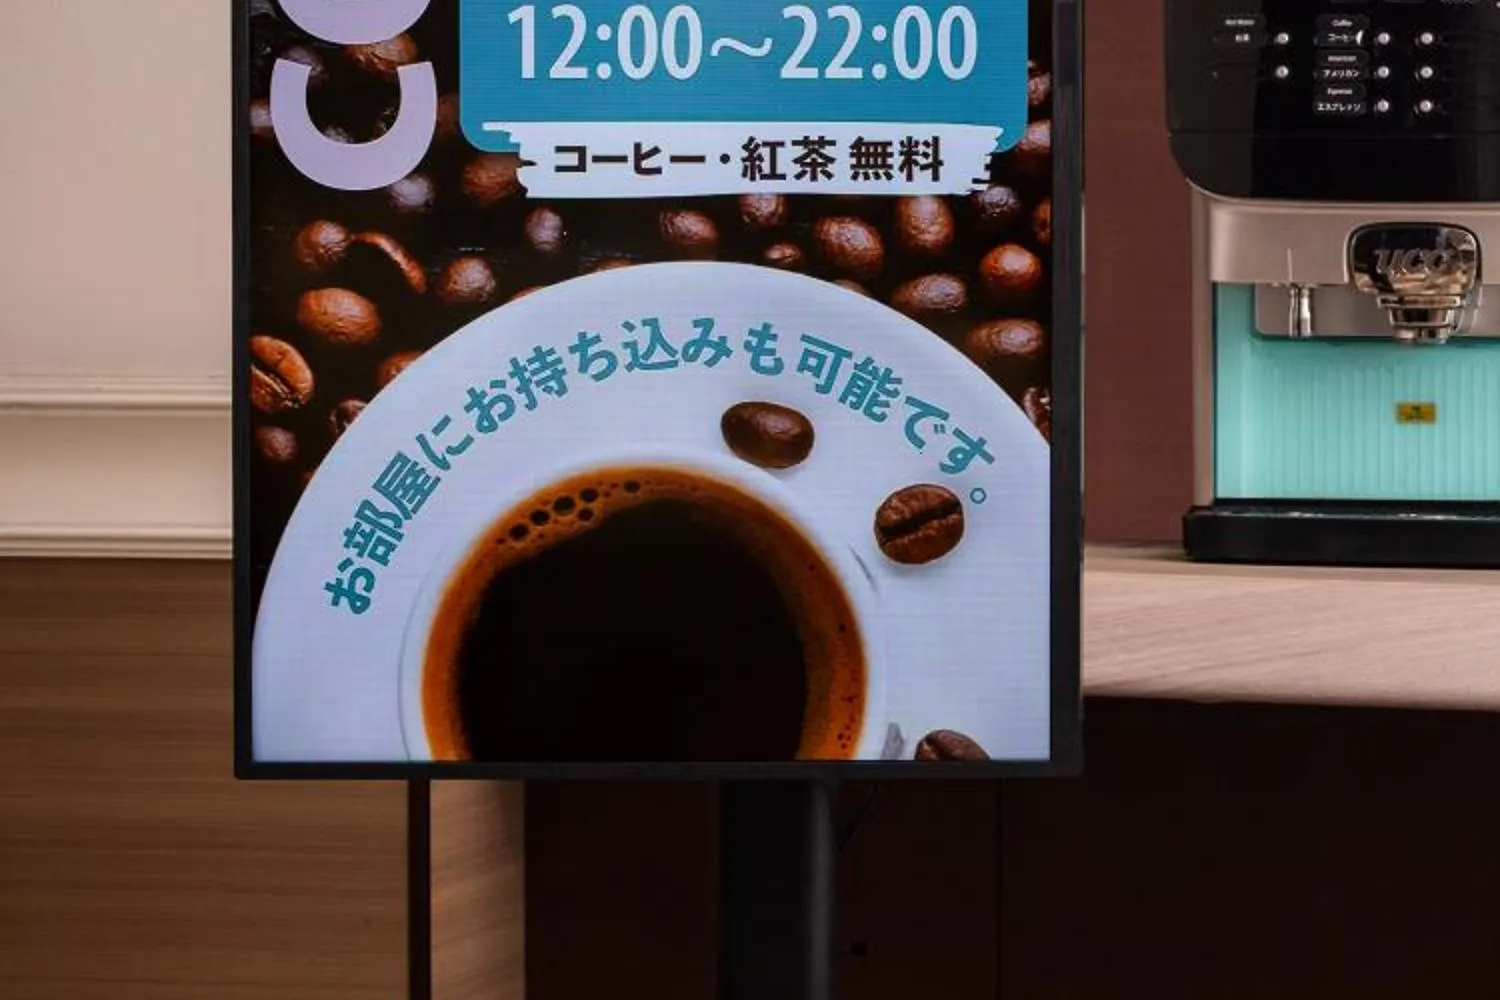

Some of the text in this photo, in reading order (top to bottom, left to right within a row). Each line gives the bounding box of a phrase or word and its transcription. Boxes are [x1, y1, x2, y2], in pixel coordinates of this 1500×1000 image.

[324, 317, 997, 617] お部屋にお持ち込みも可能です。
